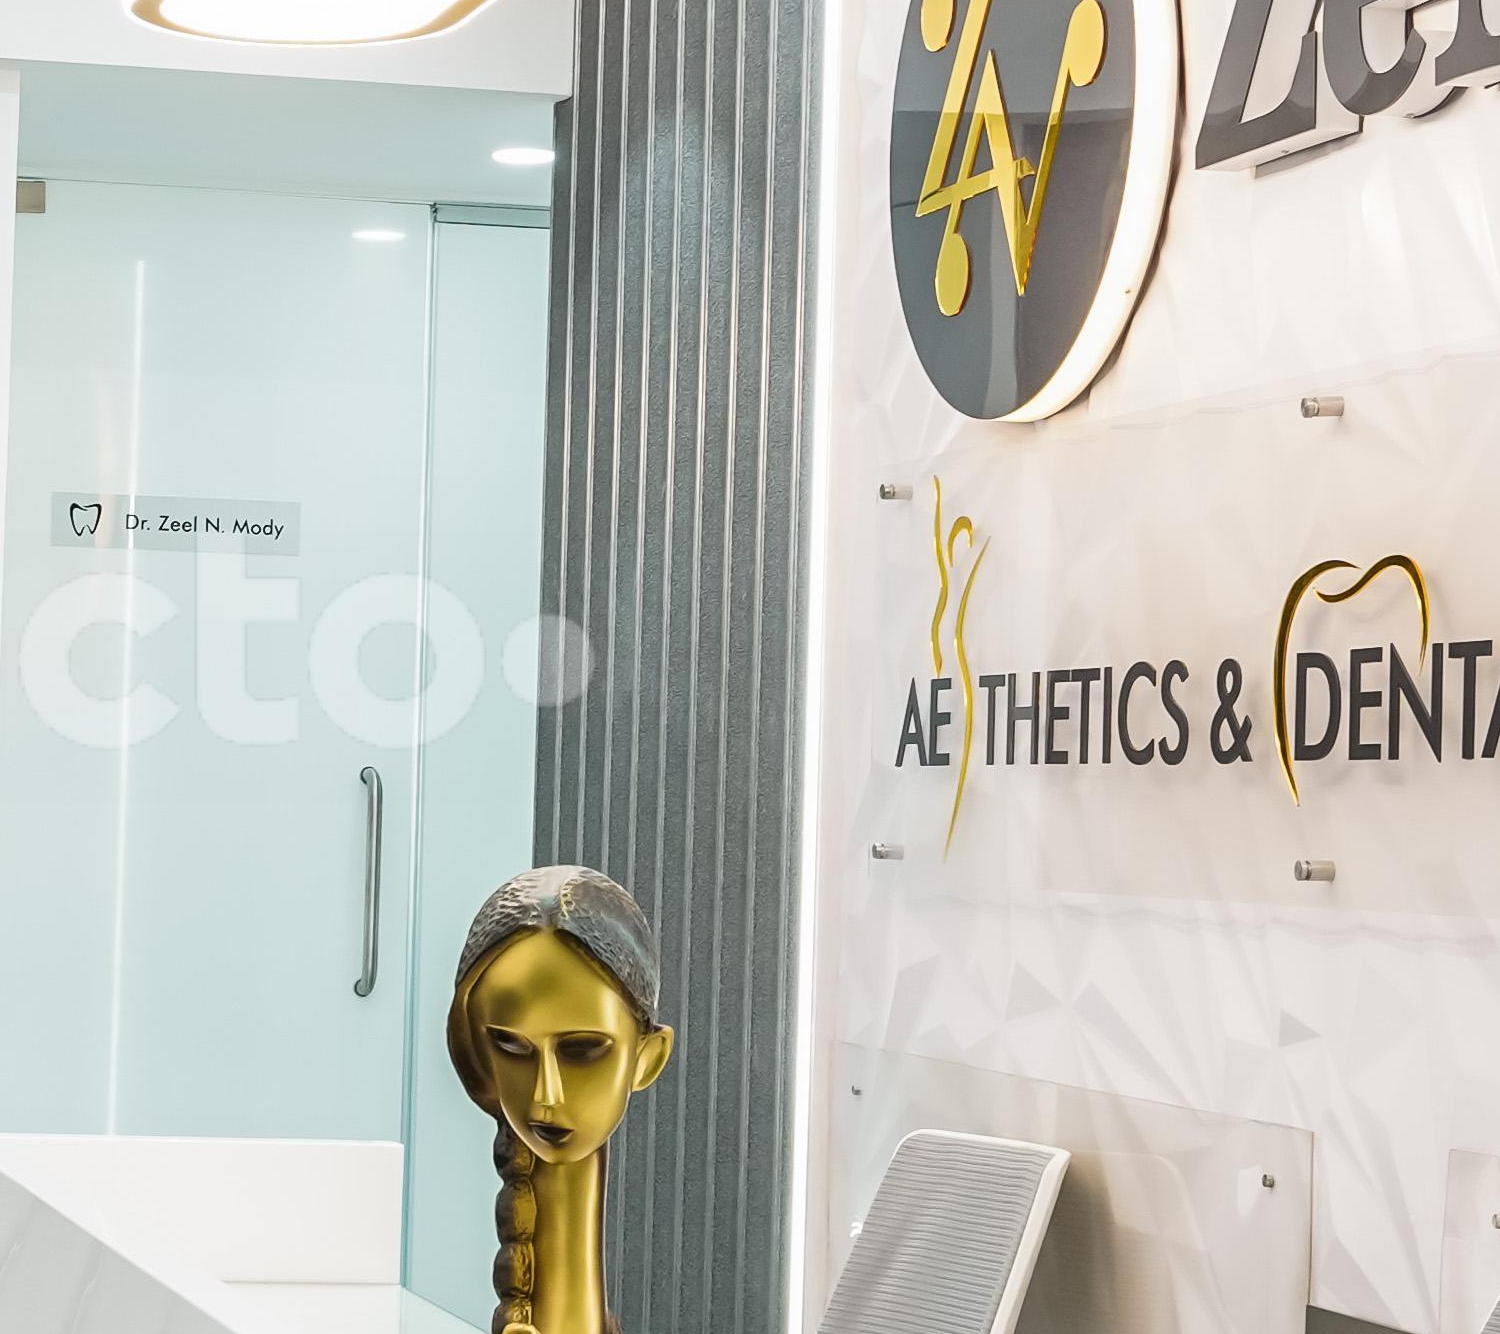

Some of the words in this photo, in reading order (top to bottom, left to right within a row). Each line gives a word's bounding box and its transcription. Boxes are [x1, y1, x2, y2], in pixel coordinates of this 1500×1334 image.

[125, 514, 151, 531] Dr.
[158, 515, 198, 533] Zeel
[205, 517, 225, 534] N.
[232, 519, 285, 541] Mody
[1209, 657, 1254, 766] &
